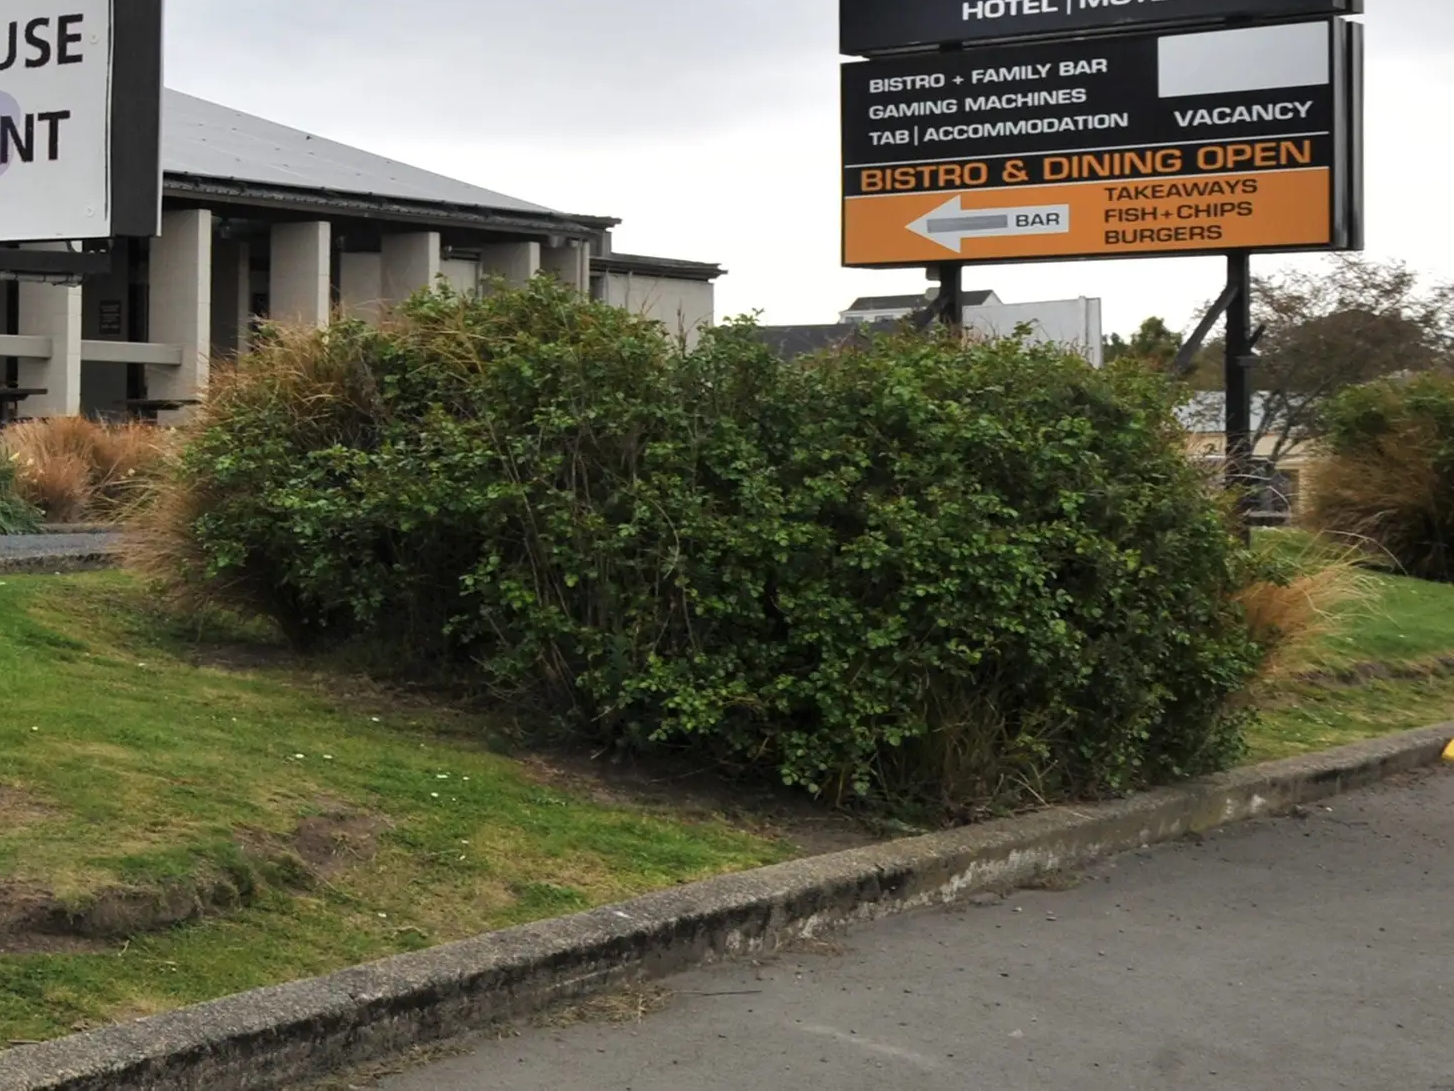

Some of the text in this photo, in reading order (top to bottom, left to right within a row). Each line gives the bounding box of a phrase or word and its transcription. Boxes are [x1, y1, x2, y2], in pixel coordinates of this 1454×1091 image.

[869, 73, 945, 93] BISTRO
[971, 63, 1052, 85] FAMILY
[1058, 58, 1108, 77] BAR
[869, 88, 1087, 120] GAMING MACHINES
[1174, 100, 1313, 128] VACANCY
[869, 112, 1129, 146] TAB ACCOMMODATION
[860, 139, 1312, 193] BISTRO & DINING OPEN
[1104, 178, 1259, 202] TAKEAWAYS
[1015, 212, 1061, 228] BAR
[1104, 224, 1223, 245] BURGERS
